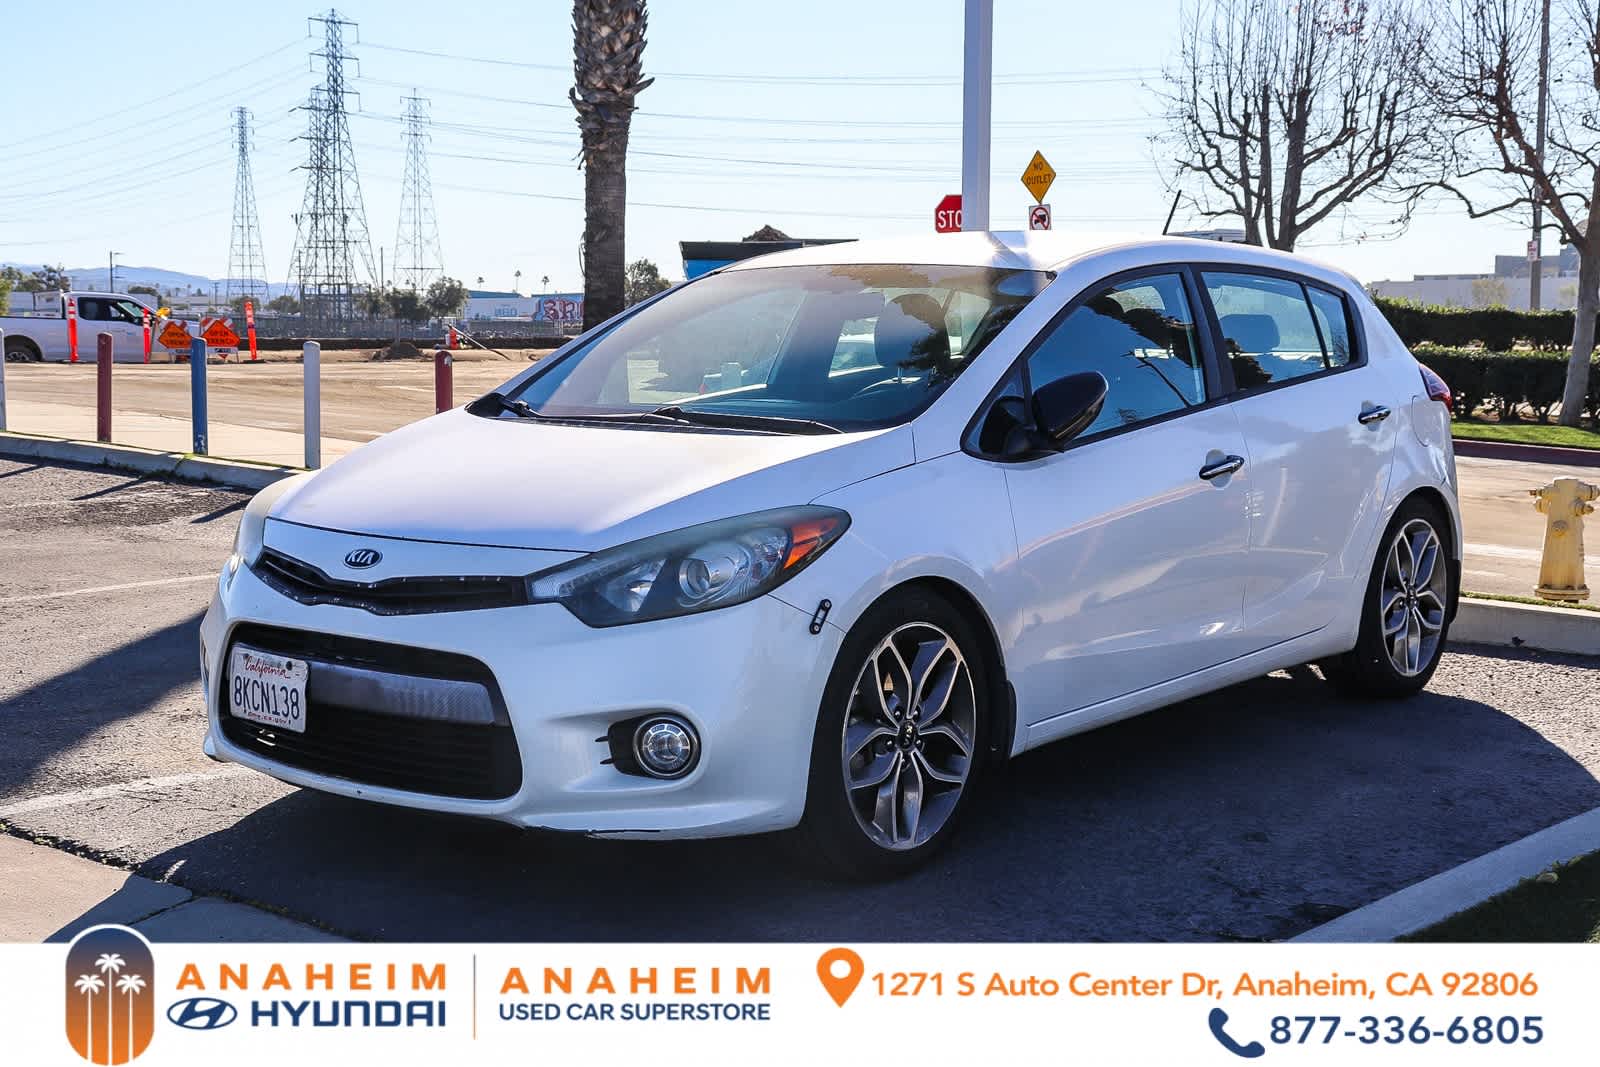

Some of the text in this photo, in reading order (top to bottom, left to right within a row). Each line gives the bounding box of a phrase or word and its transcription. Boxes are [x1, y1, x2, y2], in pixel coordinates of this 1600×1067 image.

[1033, 161, 1043, 171] NO
[1026, 173, 1051, 185] OUTLET
[937, 209, 962, 228] STO
[347, 551, 375, 564] KIA
[245, 655, 291, 679] California
[234, 675, 300, 720] 8KCN138
